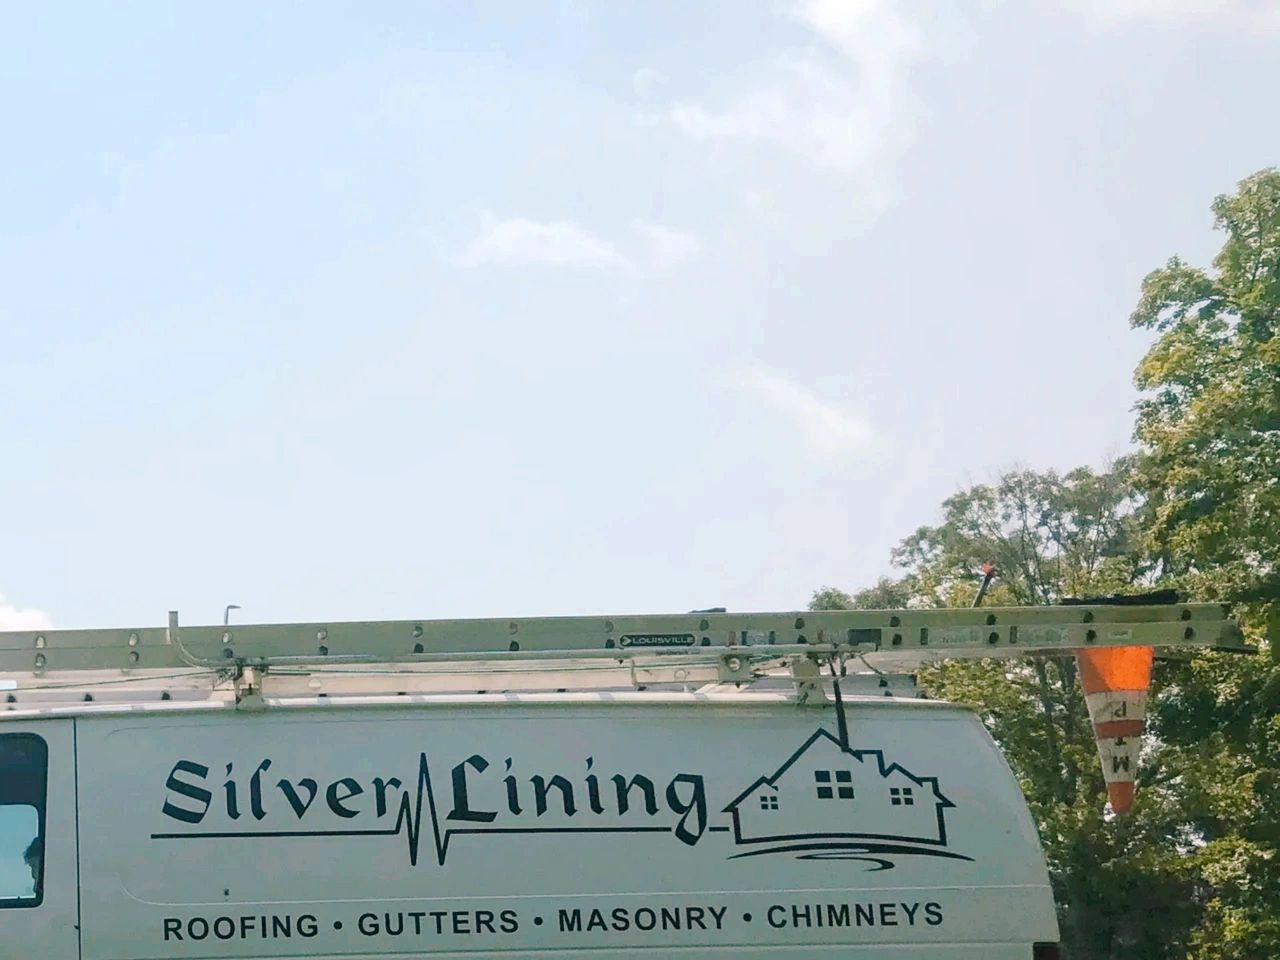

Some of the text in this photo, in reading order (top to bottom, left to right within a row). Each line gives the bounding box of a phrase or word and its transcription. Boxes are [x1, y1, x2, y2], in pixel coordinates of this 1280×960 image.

[632, 635, 695, 646] LOUISVILLE
[161, 754, 708, 847] Silver Lining
[163, 901, 944, 941] ROOFING GUTTERS MASONRY CHIMNEYS
